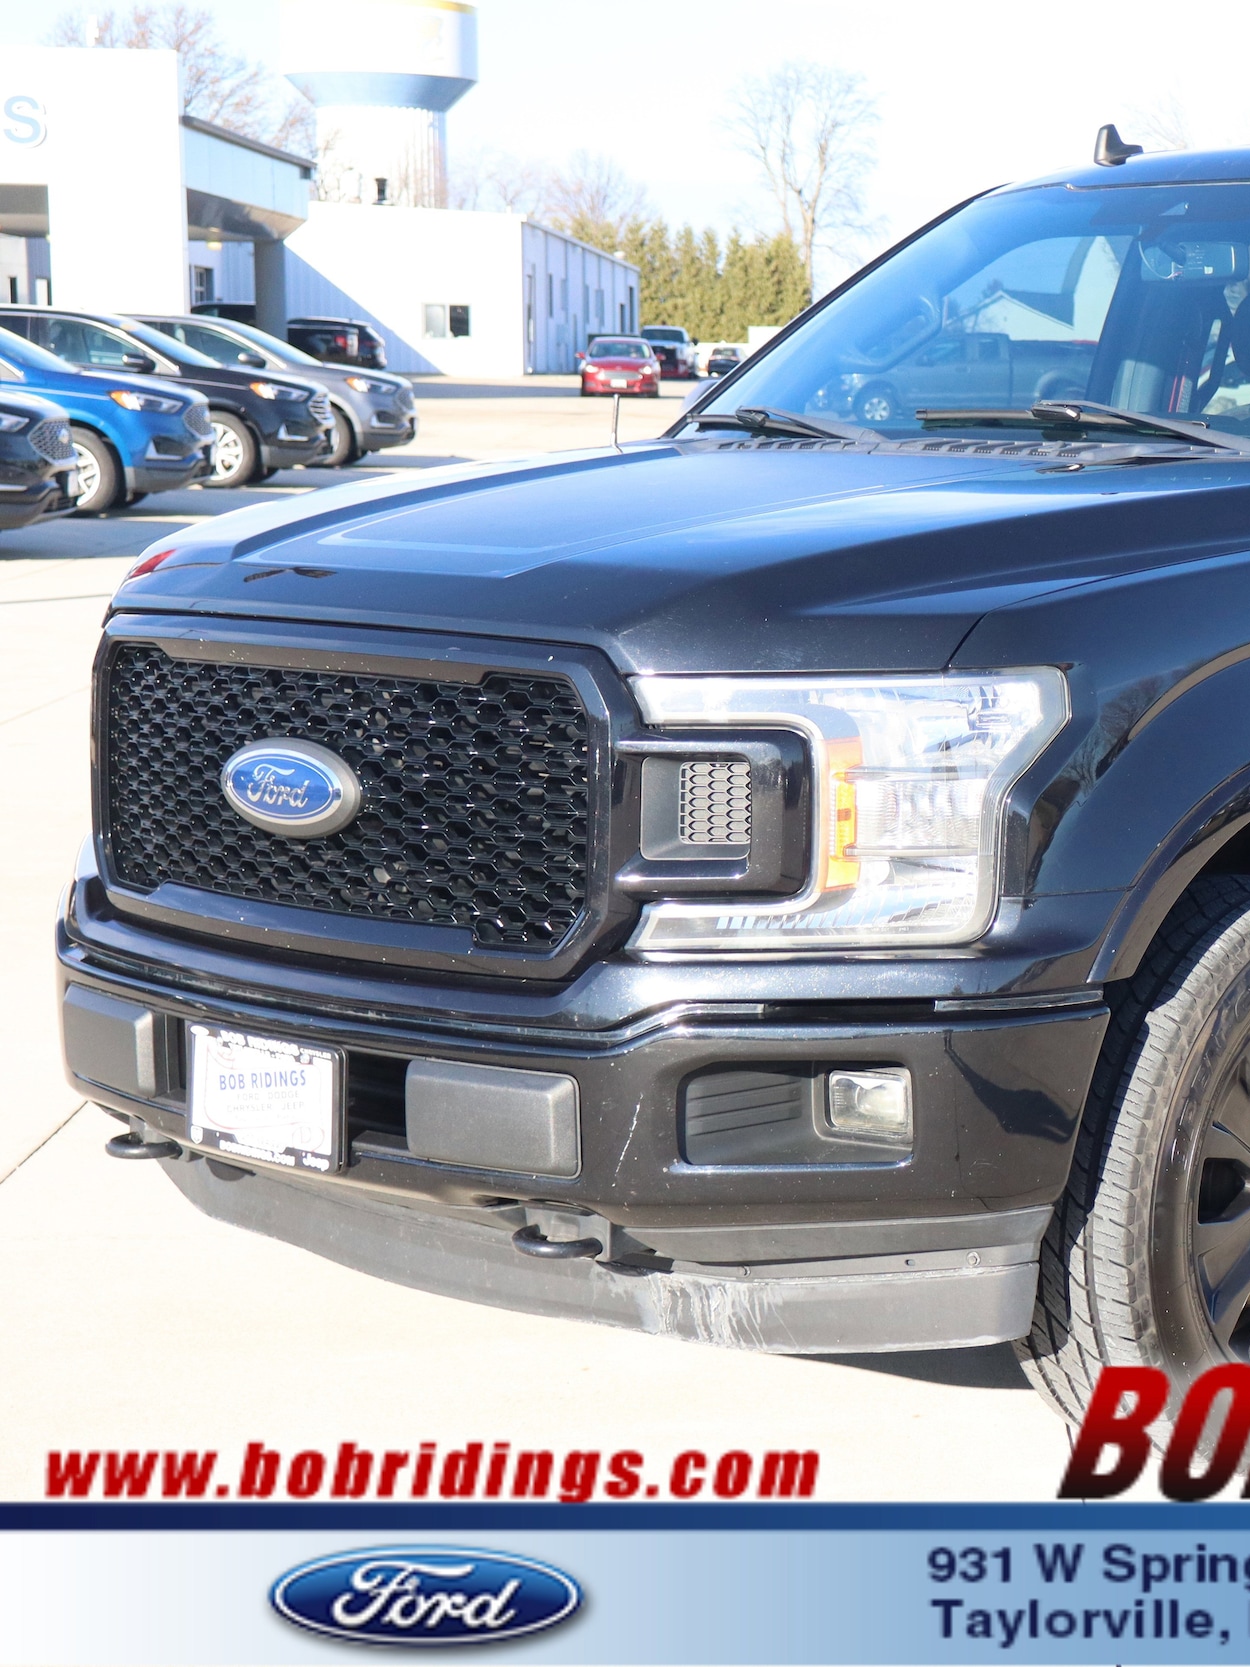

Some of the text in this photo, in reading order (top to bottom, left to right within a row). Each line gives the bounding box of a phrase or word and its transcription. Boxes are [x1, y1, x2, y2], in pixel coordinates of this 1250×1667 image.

[247, 763, 310, 808] Ford
[219, 1069, 307, 1091] BOB RIDINGS
